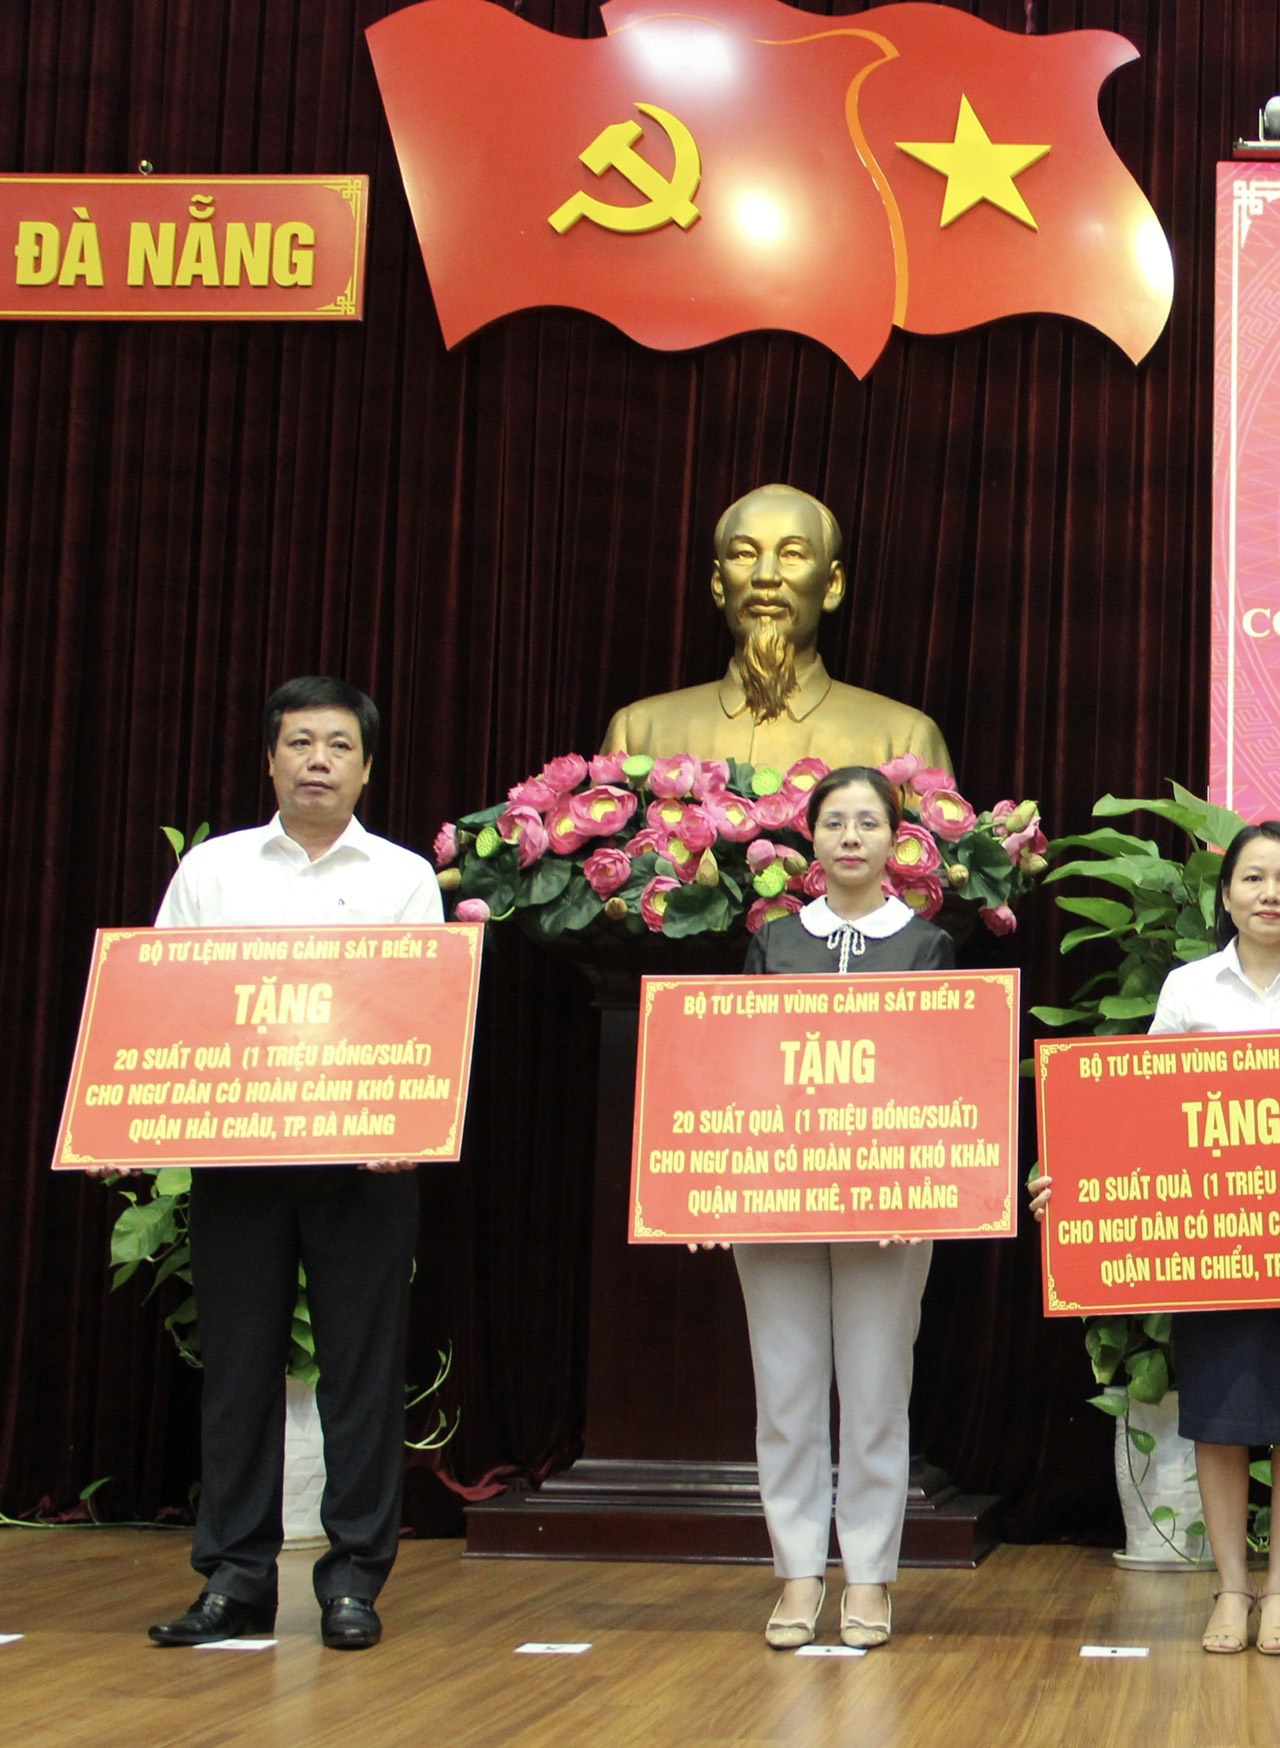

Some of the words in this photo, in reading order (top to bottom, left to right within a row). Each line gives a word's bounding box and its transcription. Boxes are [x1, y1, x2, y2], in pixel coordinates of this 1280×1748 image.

[14, 206, 104, 286] ĐÀ
[127, 194, 317, 287] NẴNG
[234, 975, 333, 1034] TẶNG
[683, 989, 706, 1018] BỘ
[710, 993, 734, 1014] TƯ
[736, 990, 779, 1018] LỆNH
[783, 989, 828, 1013] VÙNG
[833, 986, 879, 1012] CẢNH
[884, 987, 916, 1011] SÁT
[920, 982, 959, 1010] BIỂN
[964, 989, 975, 1009] 2
[780, 1031, 875, 1094] TẶNG
[1079, 1052, 1102, 1081] BỘ
[1106, 1053, 1129, 1076] TƯ
[1132, 1050, 1176, 1079] LỆNH
[1180, 1047, 1227, 1072] VÙNG
[1232, 1042, 1279, 1070] CẢNH
[128, 1114, 182, 1144] QUẬN
[184, 1110, 218, 1139] HẢI
[221, 1112, 276, 1139] CHÂU,
[283, 1115, 306, 1136] TP.
[311, 1110, 337, 1136] ĐÀ
[342, 1107, 395, 1135] NẴNG
[672, 1110, 694, 1133] 20
[699, 1102, 744, 1133] SUẤT
[748, 1104, 784, 1135] QUÀ
[795, 1108, 810, 1134] (1
[817, 1102, 867, 1135] TRIỆU
[871, 1096, 977, 1129] ĐỒNG/SUẤT)
[1181, 1090, 1280, 1157] TẶNG
[649, 1149, 685, 1173] CHO
[689, 1148, 729, 1173] NGƯ
[731, 1146, 768, 1174] DÂN
[773, 1143, 797, 1172] CÓ
[802, 1142, 851, 1171] HOÀN
[856, 1138, 904, 1170] CẢNH
[909, 1139, 945, 1168] KHÓ
[950, 1138, 999, 1167] KHĂN
[687, 1185, 737, 1218] QUẬN
[742, 1188, 800, 1212] THANH
[805, 1182, 845, 1213] KHÊ,
[850, 1186, 873, 1210] TP.
[878, 1181, 902, 1209] ĐÀ
[908, 1176, 958, 1209] NẴNG
[1078, 1178, 1100, 1202] 20
[1105, 1167, 1150, 1201] SUẤT
[1155, 1168, 1192, 1201] QUÀ
[1203, 1172, 1218, 1199] (1
[1225, 1165, 1276, 1199] TRIỆU
[1058, 1219, 1093, 1244] CHO
[1098, 1215, 1137, 1242] NGƯ
[1141, 1211, 1178, 1240] DÂN
[1183, 1209, 1208, 1239] CÓ
[1213, 1207, 1263, 1237] HOÀN
[1100, 1253, 1150, 1287] QUẬN
[1155, 1251, 1195, 1281] LIÊN
[1200, 1244, 1259, 1280] CHIỂU,
